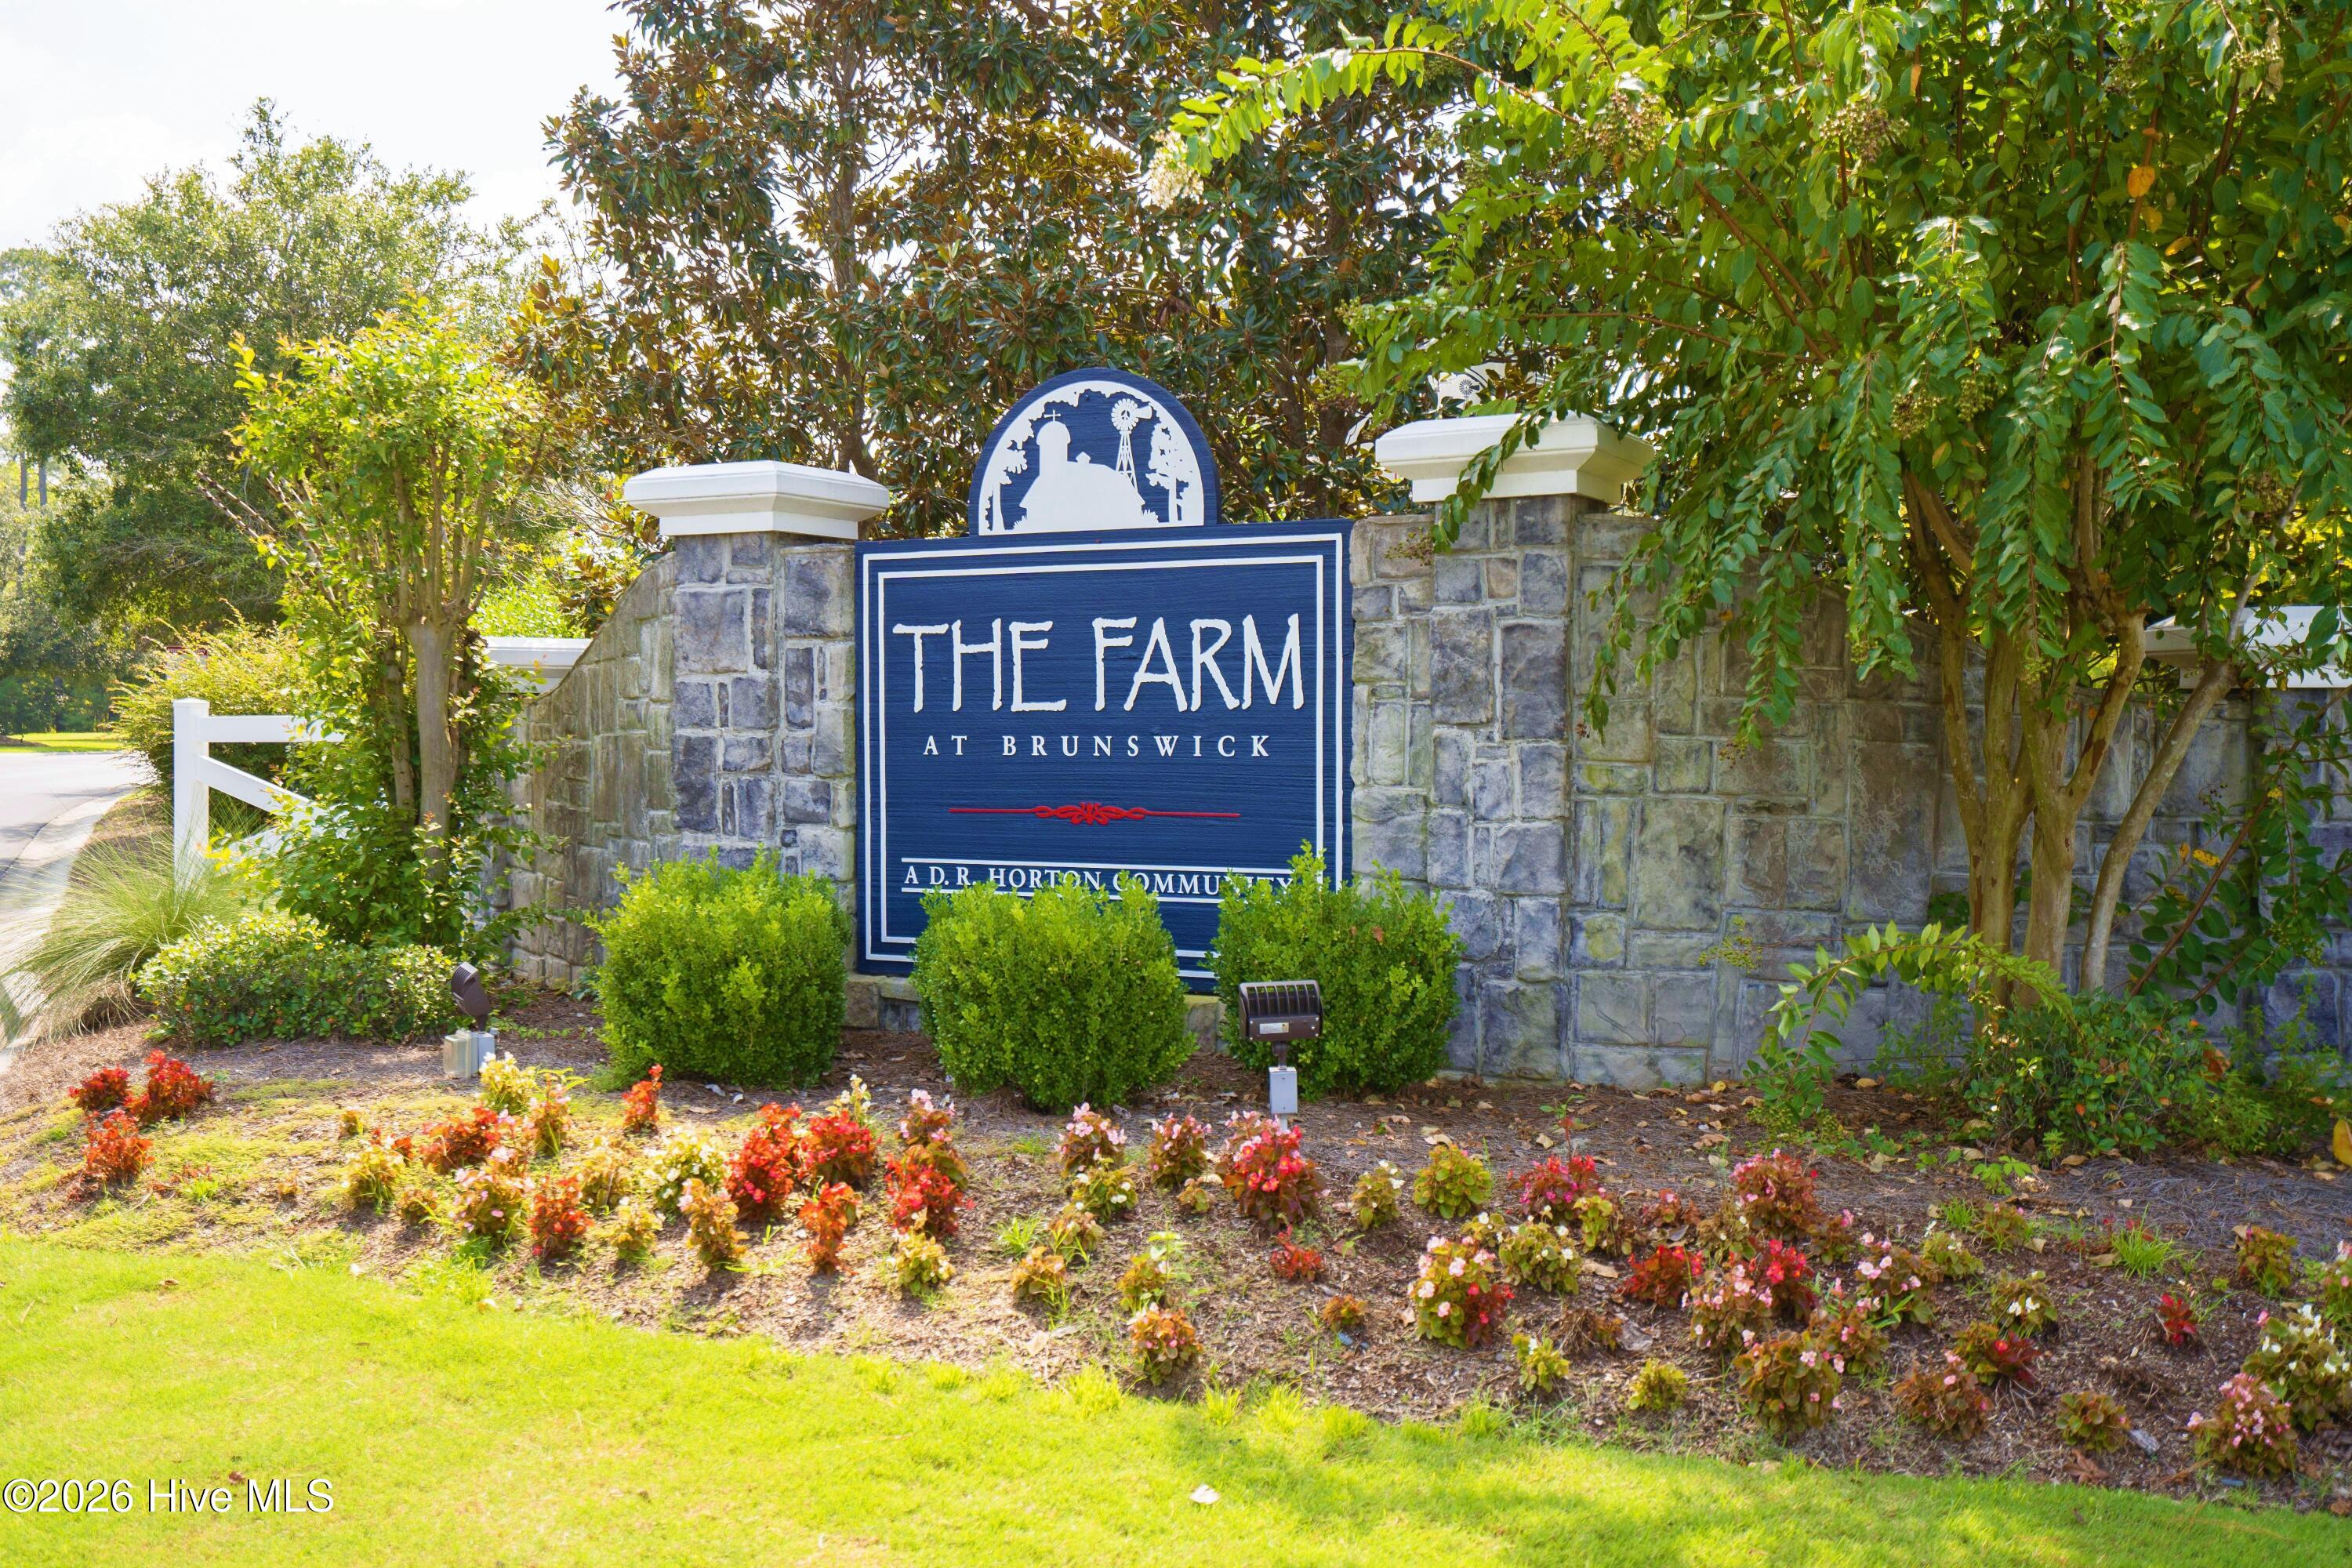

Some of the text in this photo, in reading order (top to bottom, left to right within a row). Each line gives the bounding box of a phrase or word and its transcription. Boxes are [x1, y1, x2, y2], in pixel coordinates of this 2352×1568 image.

[892, 613, 1304, 713] THE FARM
[923, 735, 1270, 757] AT BRUNSWICK
[904, 866, 920, 884] A
[988, 868, 1102, 891] HORTON
